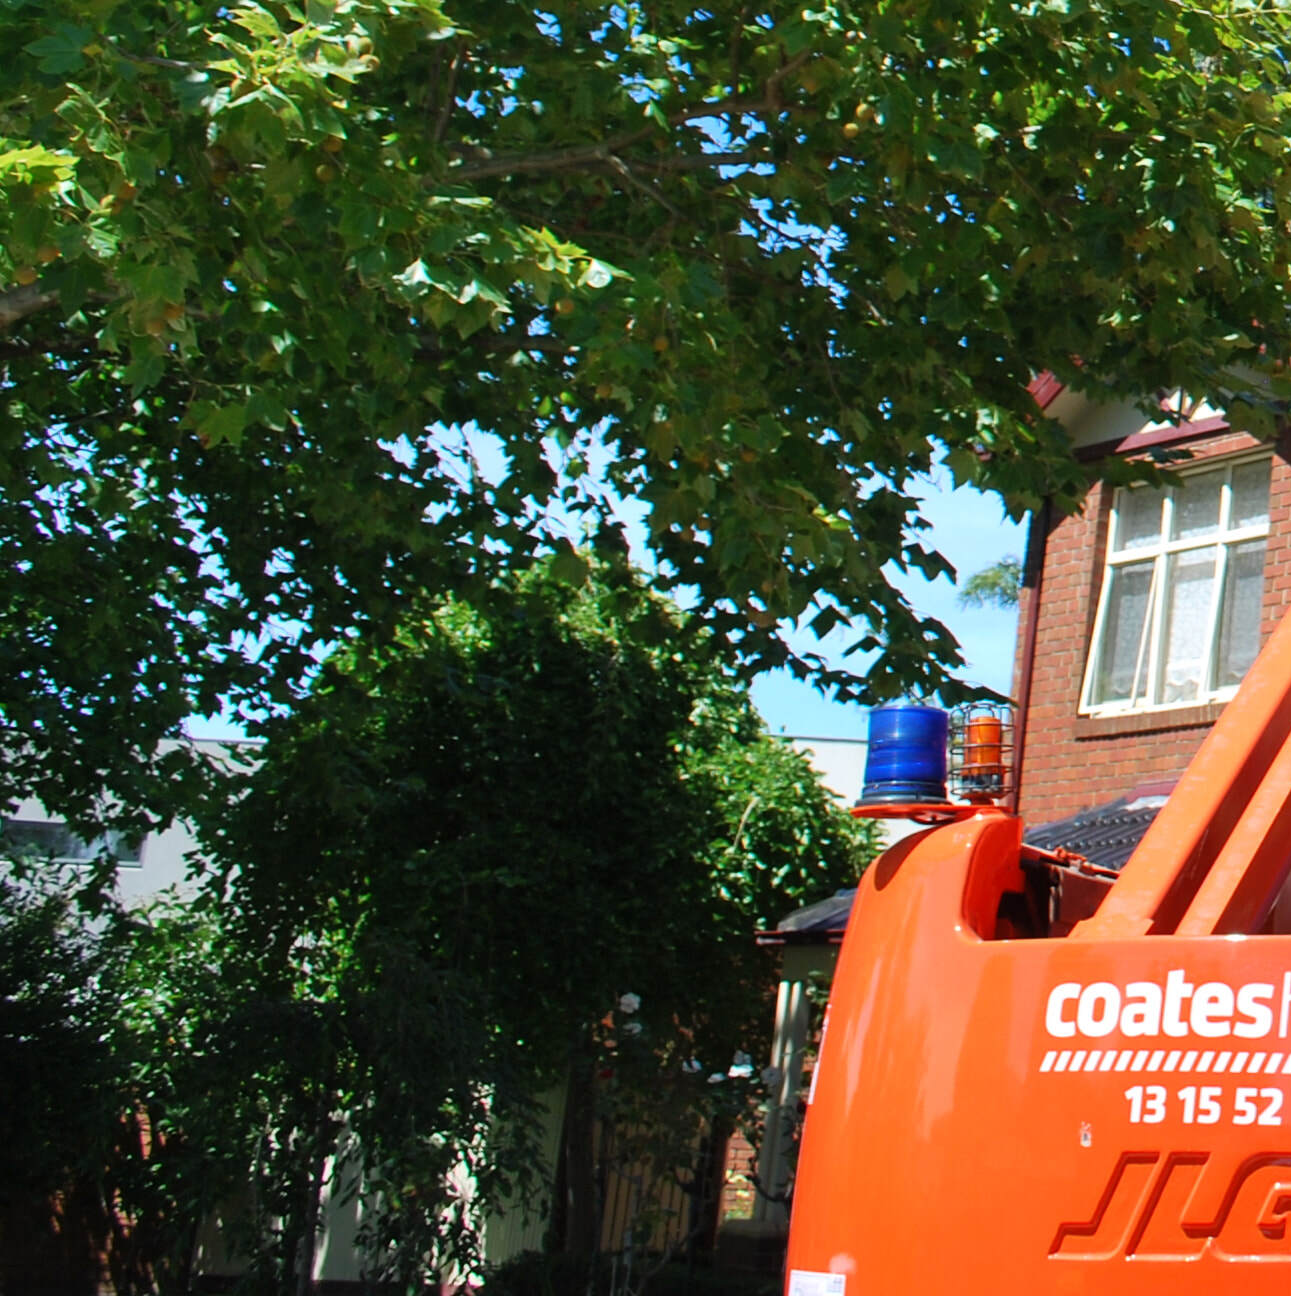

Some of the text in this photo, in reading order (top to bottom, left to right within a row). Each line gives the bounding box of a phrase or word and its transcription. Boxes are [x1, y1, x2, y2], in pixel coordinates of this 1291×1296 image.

[1124, 1085, 1284, 1126] 13 15 52
